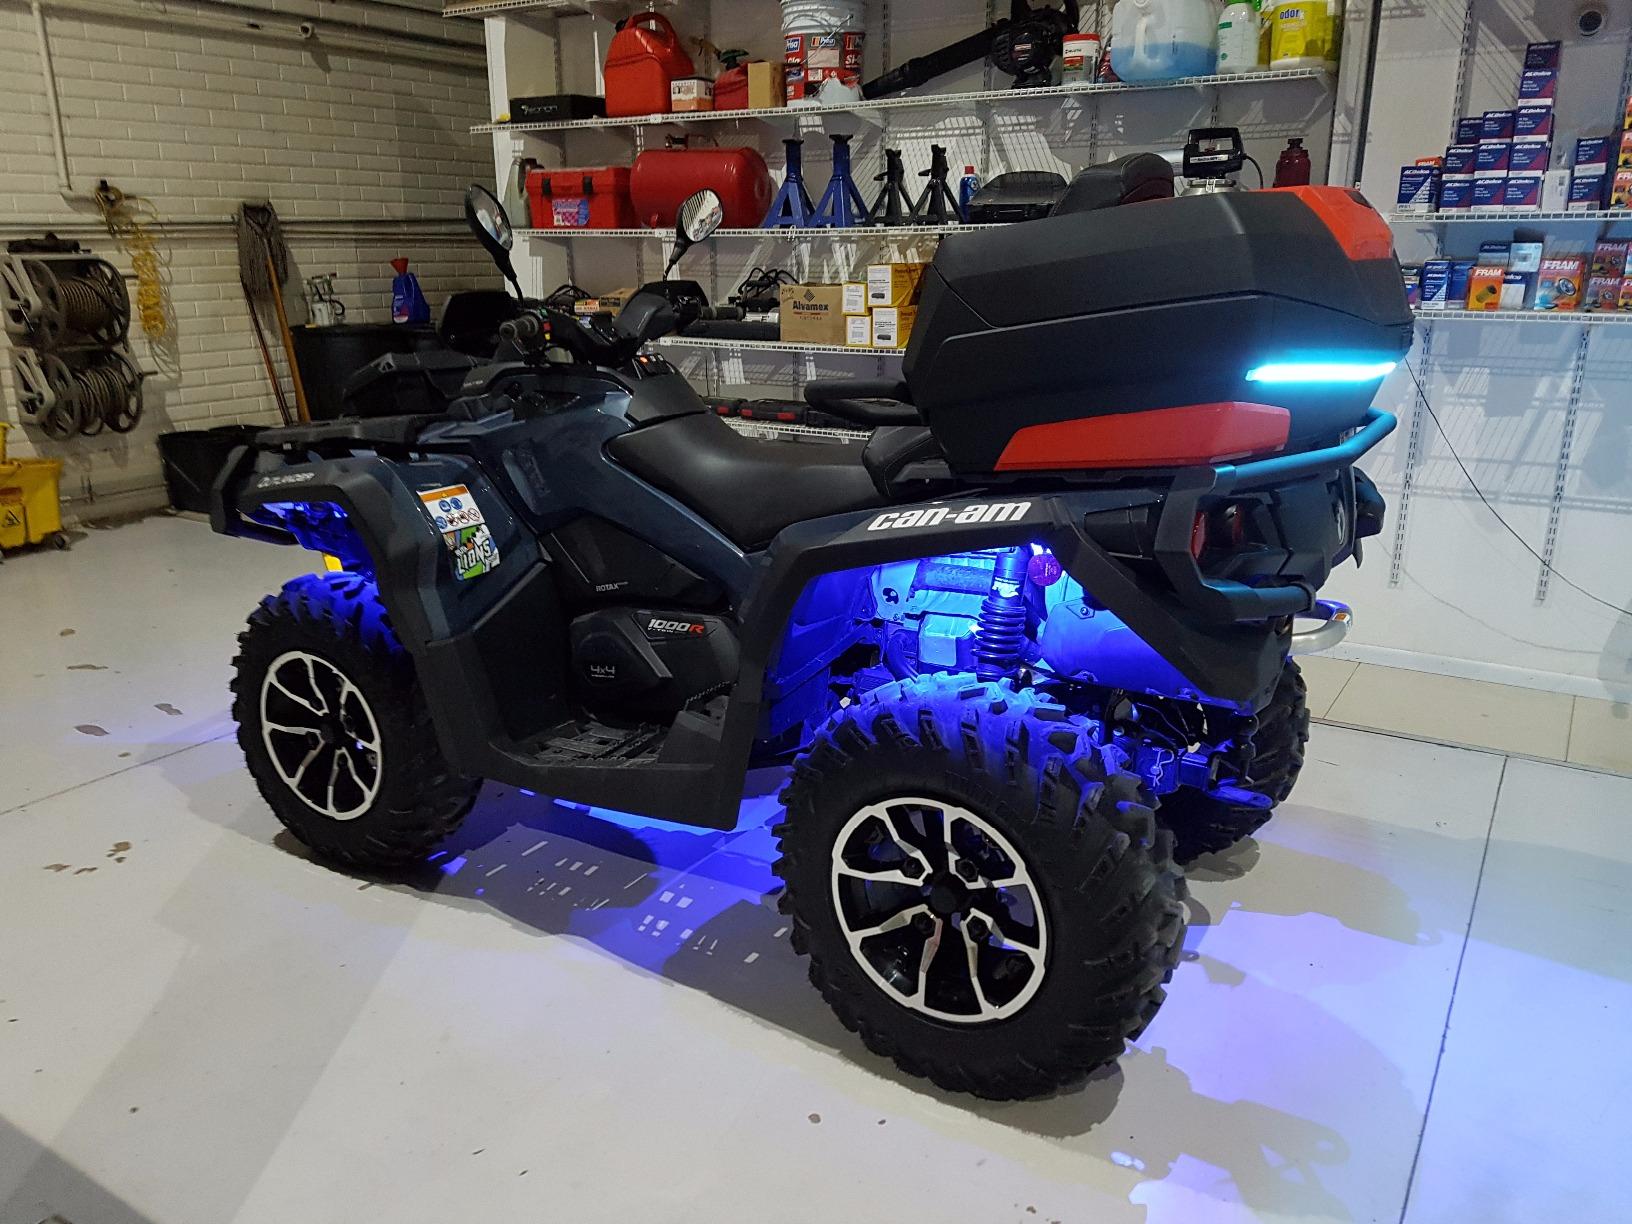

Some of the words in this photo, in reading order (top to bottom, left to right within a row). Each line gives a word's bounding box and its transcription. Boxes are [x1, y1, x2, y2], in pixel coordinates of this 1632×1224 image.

[1598, 243, 1628, 251] FRAM
[1543, 260, 1580, 270] FRAM
[1474, 269, 1502, 277] FRAM
[1592, 277, 1621, 285] FRAM
[792, 300, 829, 311] Alvamex
[867, 501, 1032, 532] can-am
[596, 583, 619, 592] ROTAX
[648, 618, 705, 634] 1000R
